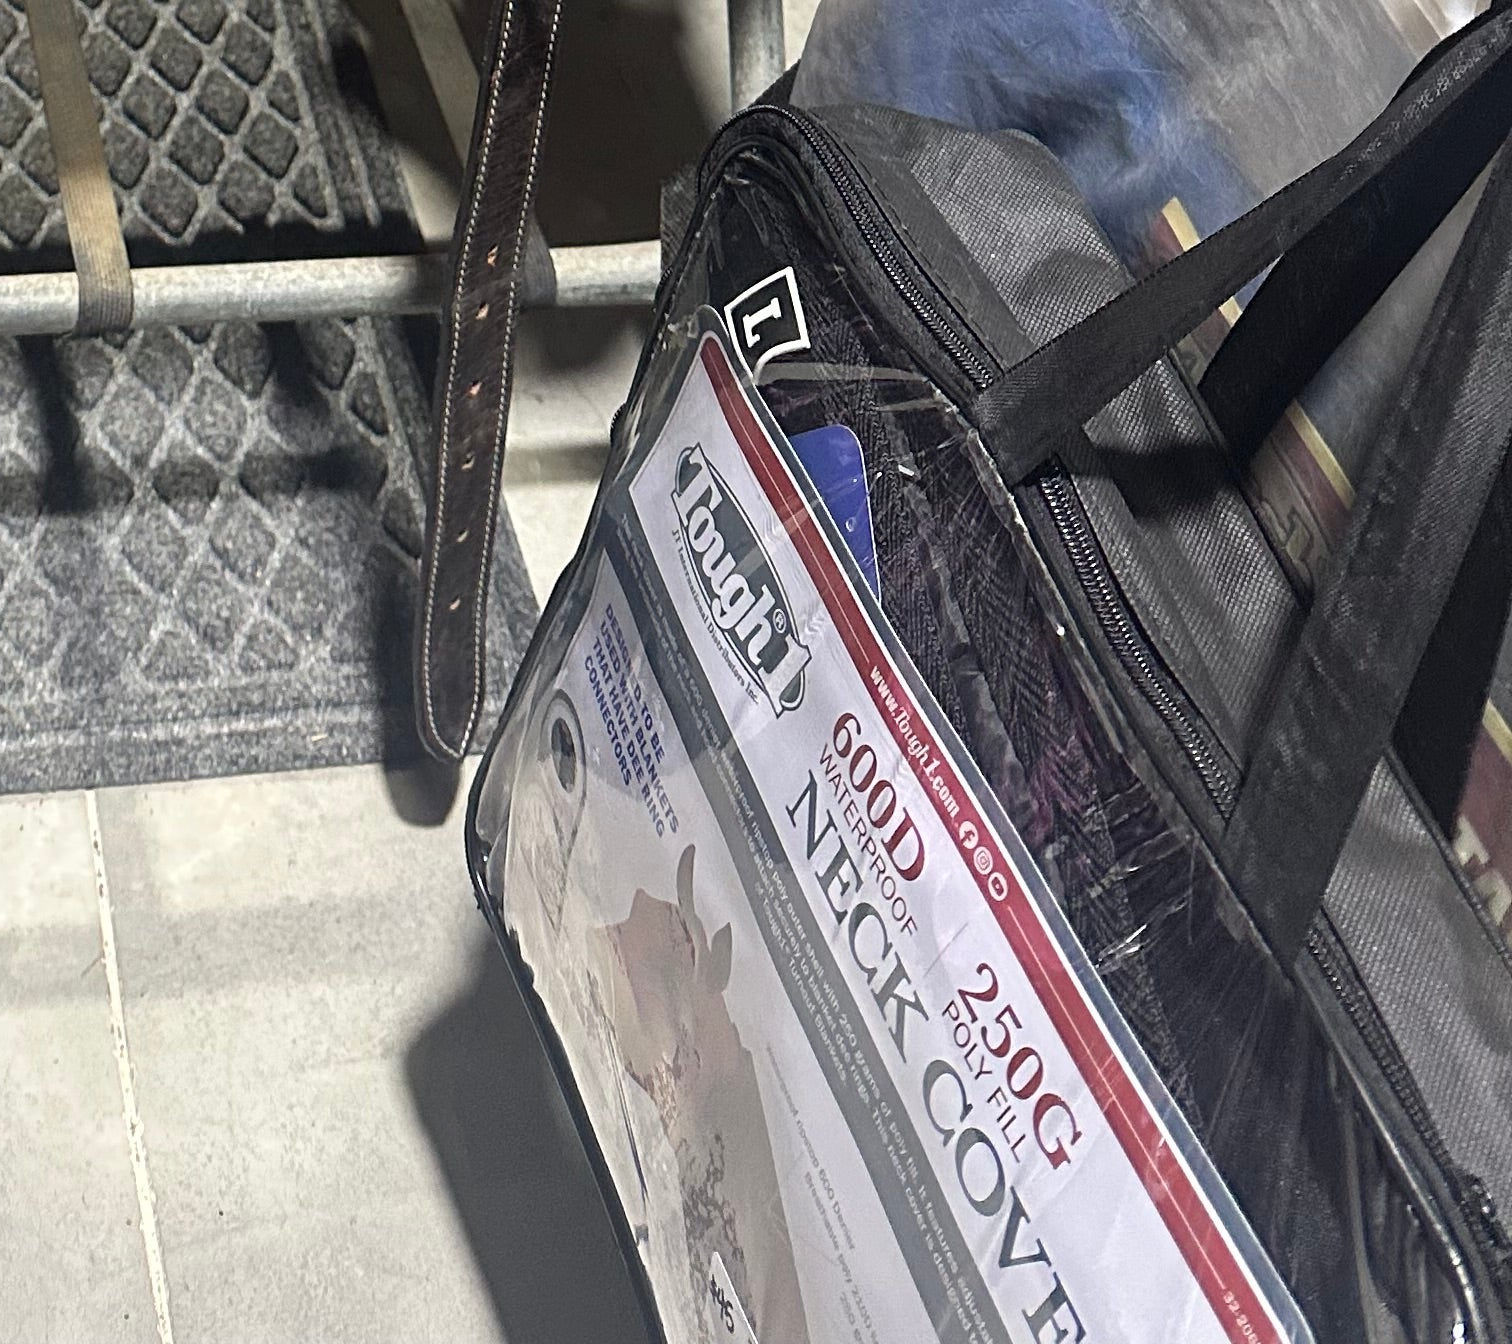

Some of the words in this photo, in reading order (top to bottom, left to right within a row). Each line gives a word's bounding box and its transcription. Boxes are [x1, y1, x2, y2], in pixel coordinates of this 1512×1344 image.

[670, 528, 682, 544] JT
[677, 545, 709, 623] International
[704, 621, 748, 686] Distributors
[743, 683, 761, 705] Inc.
[583, 654, 634, 787] CONNECTORS
[593, 635, 612, 686] THAT
[608, 686, 630, 739] HAVE
[626, 739, 646, 784] DEE
[640, 782, 666, 838] RING
[599, 620, 622, 675] USED
[617, 673, 638, 727] WITH
[635, 728, 680, 834] BLANKETS
[640, 701, 653, 731] TO
[649, 731, 665, 764] BE
[833, 710, 927, 883] 600D
[868, 665, 961, 819] www.Tough1.com
[784, 768, 929, 1064] NECK
[820, 742, 919, 937] WATERPROOF
[720, 749, 755, 819] waterproof
[750, 820, 776, 870] ripstop
[770, 869, 789, 900] poly
[784, 901, 807, 940] outer
[803, 941, 825, 978] shell
[821, 980, 841, 1013] with
[838, 1012, 858, 1047] 250
[852, 1049, 882, 1101] grams
[879, 1100, 892, 1118] of
[888, 1121, 908, 1154] poly
[924, 1202, 960, 1274] features
[745, 835, 756, 853] to
[752, 852, 776, 899] attach
[772, 899, 802, 956] securely
[798, 957, 809, 974] to
[806, 974, 837, 1032] blanket
[833, 1032, 852, 1064] dee
[871, 1108, 889, 1144] This
[886, 1144, 906, 1185] neck
[903, 1186, 927, 1233] cover
[923, 1232, 934, 1250] is
[931, 1251, 974, 1335] designed
[788, 957, 816, 1015] Turnout
[812, 1013, 850, 1087] Blankets.
[940, 999, 993, 1081] POLY
[985, 1086, 1027, 1164] FILL
[956, 960, 1083, 1170] 250G
[795, 1117, 821, 1169] ripstop
[816, 1167, 837, 1202] 600
[829, 1199, 857, 1251] Denier
[802, 1170, 840, 1253] Breathable
[836, 1252, 853, 1284] poly
